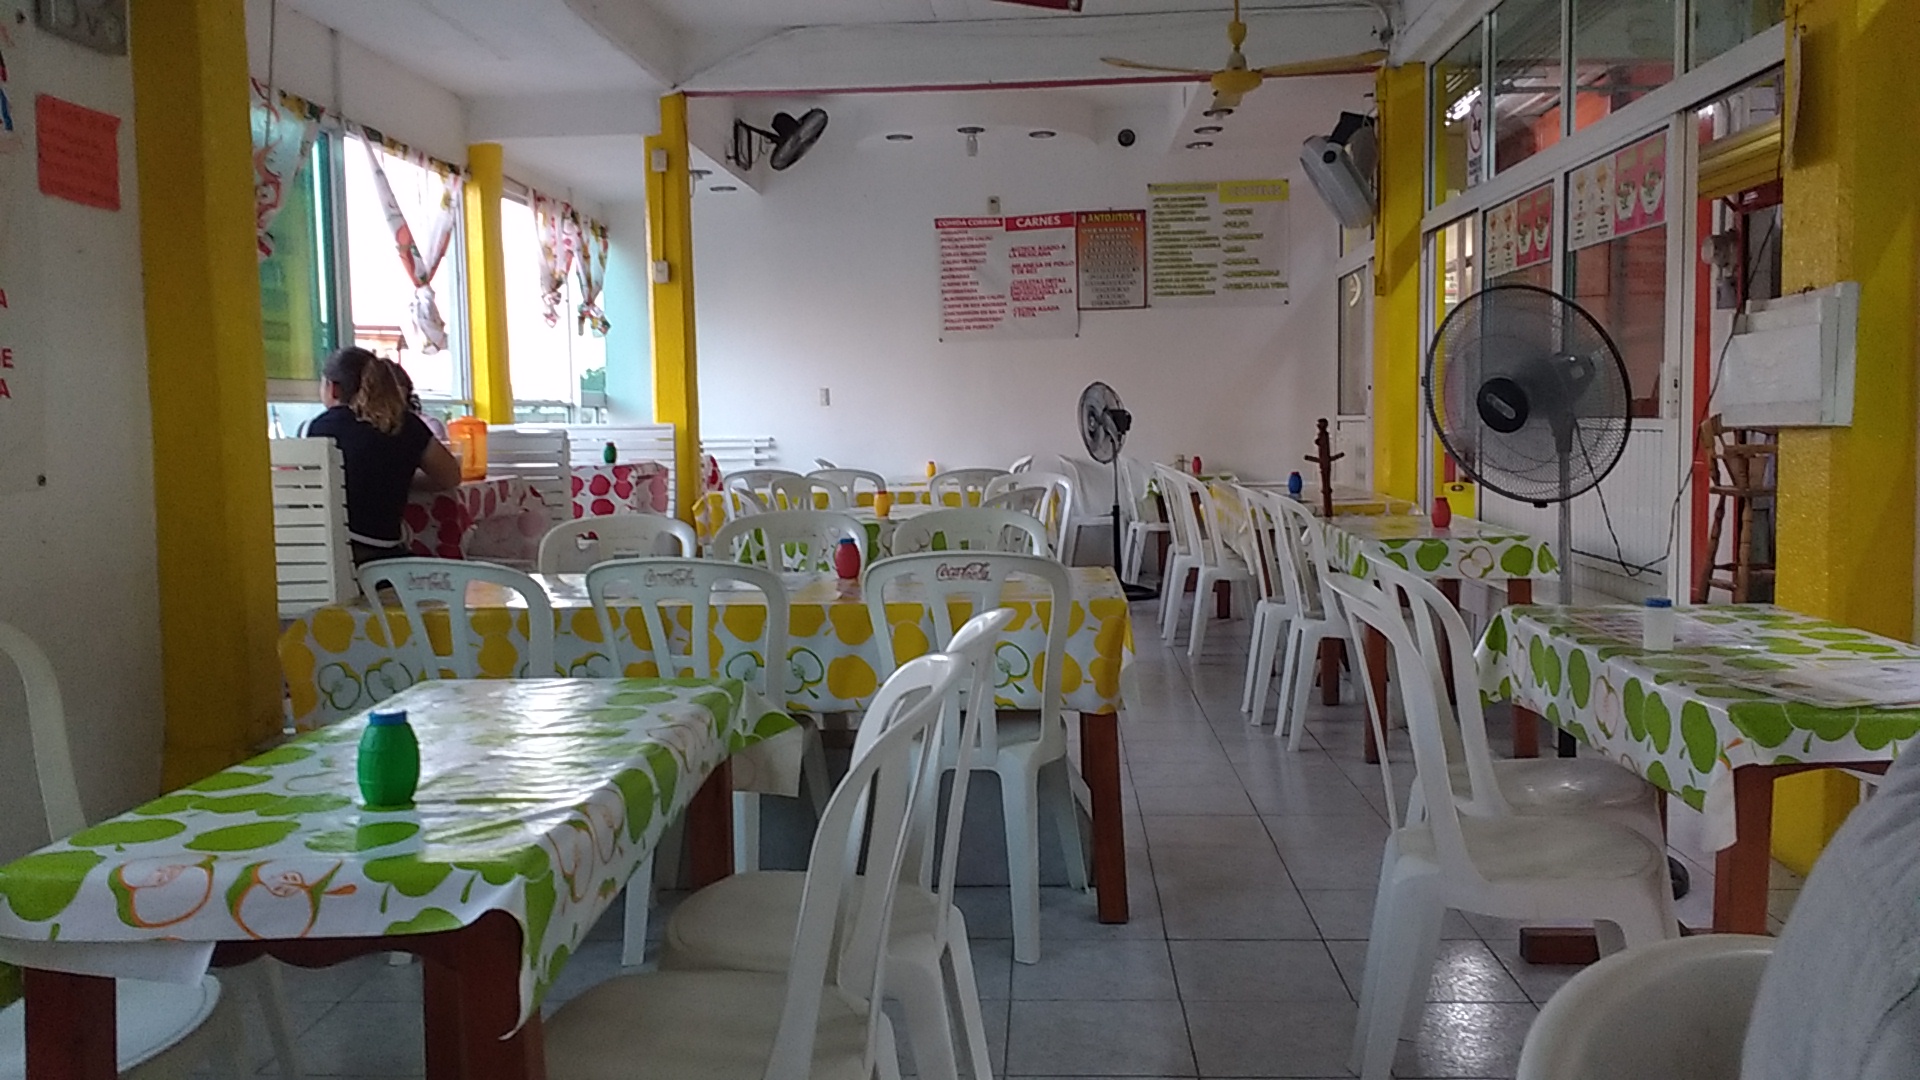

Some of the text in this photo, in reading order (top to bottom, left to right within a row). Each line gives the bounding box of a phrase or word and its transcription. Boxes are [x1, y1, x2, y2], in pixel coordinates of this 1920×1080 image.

[937, 219, 967, 227] COMIDA
[1015, 215, 1062, 228] CARNES
[1087, 213, 1135, 223] ANTOJITOS
[936, 562, 992, 582] Coca-Cola
